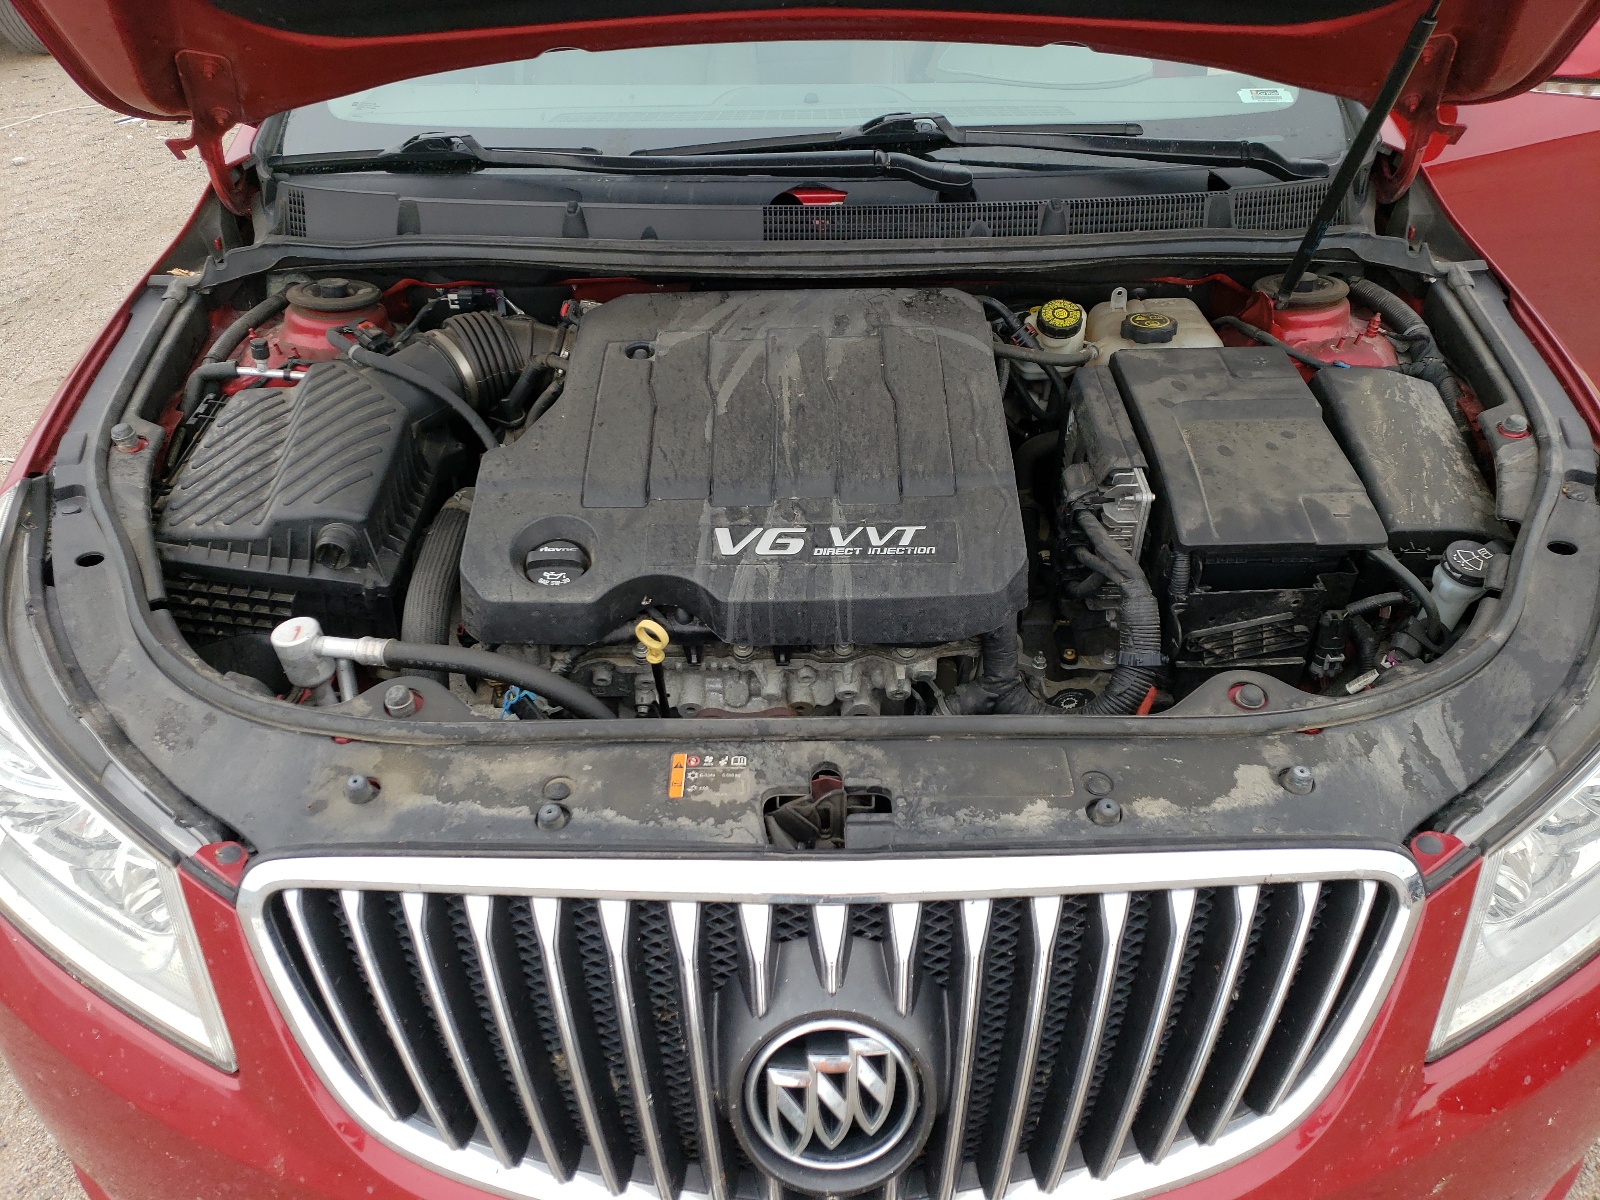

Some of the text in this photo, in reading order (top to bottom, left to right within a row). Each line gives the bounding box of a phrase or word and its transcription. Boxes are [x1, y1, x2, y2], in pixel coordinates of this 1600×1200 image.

[715, 525, 927, 556] V6 VVT
[813, 546, 936, 556] DIRECT INJECTION
